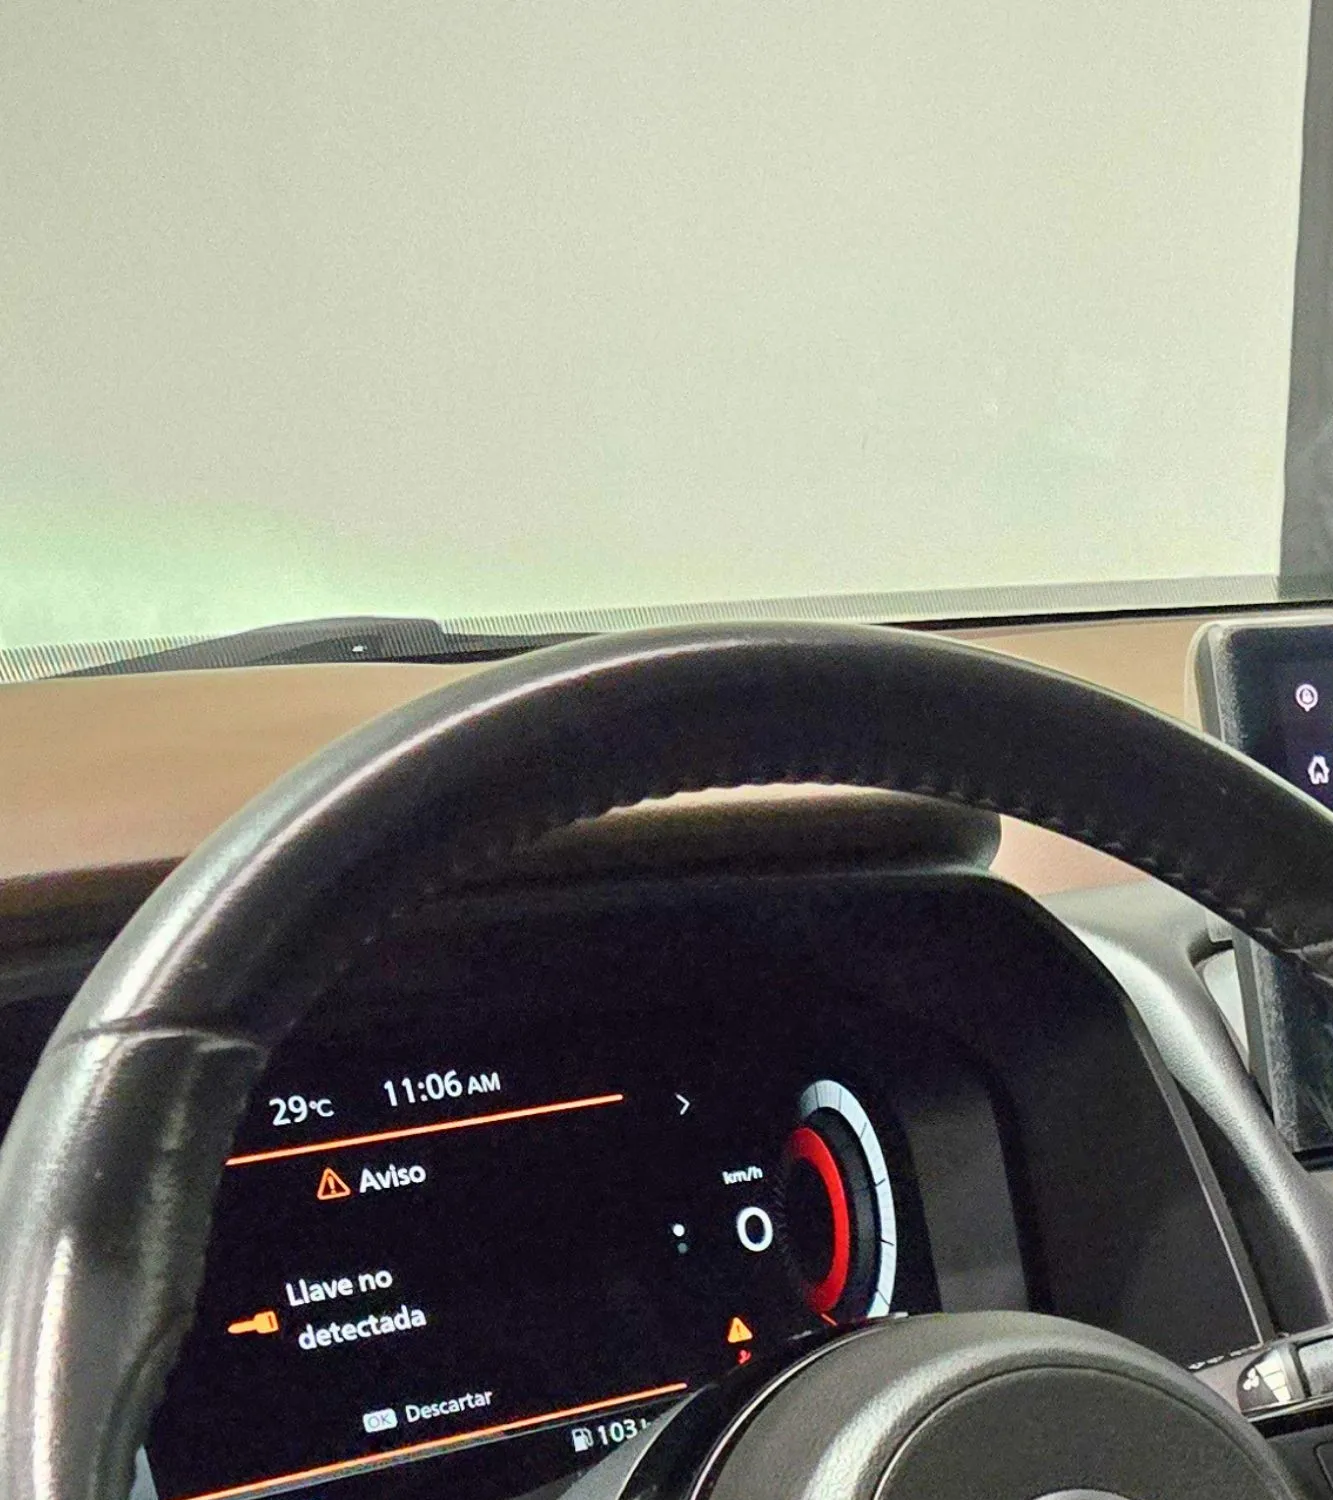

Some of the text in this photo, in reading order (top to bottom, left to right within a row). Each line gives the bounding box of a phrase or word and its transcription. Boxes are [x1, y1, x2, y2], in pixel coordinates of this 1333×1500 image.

[384, 1069, 501, 1107] 11:06 AM
[359, 1164, 427, 1194] Aviso
[722, 1165, 763, 1186] km/h
[285, 1269, 394, 1307] Llave no
[298, 1304, 427, 1351] detectada
[405, 1389, 494, 1424] Descartar
[597, 1418, 638, 1446] 103
